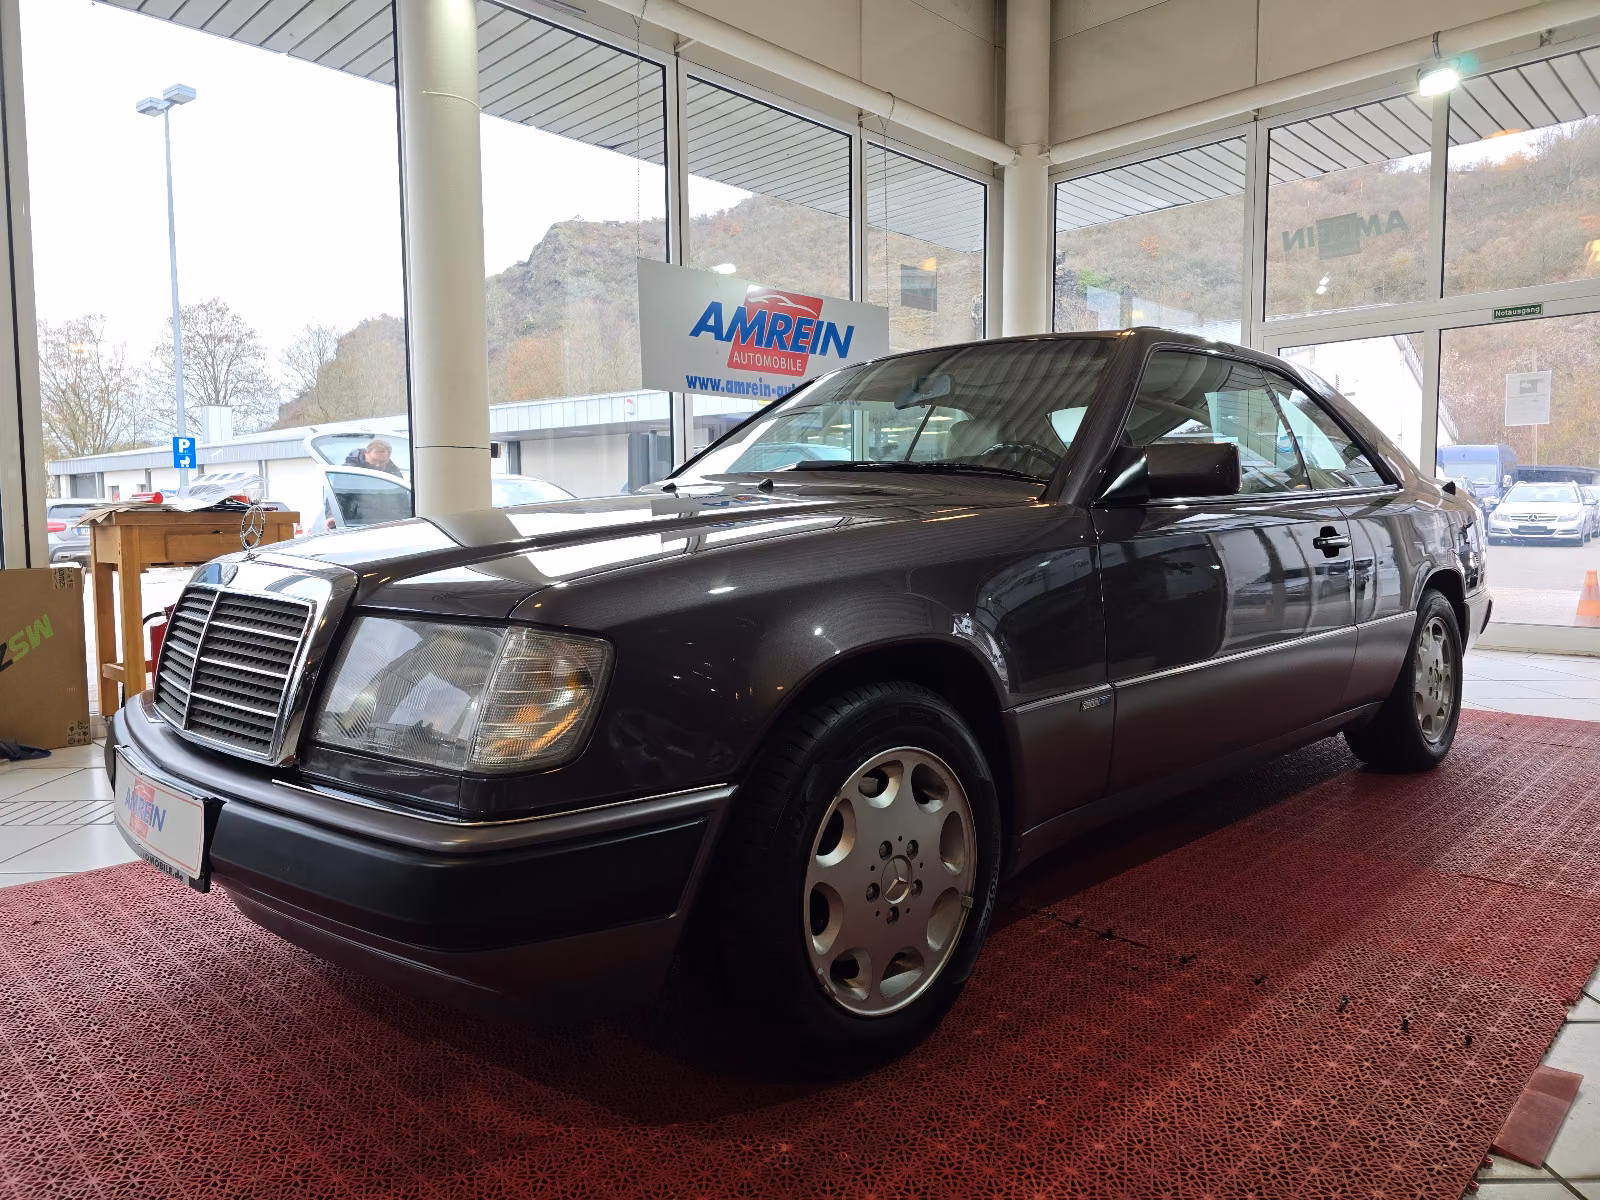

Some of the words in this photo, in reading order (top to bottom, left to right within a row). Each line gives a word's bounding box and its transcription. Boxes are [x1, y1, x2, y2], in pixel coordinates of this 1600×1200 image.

[1495, 306, 1540, 317] Notausgang
[689, 301, 854, 358] AMREIN
[733, 351, 802, 371] AUTOMOBILE
[178, 438, 190, 453] P
[124, 787, 167, 832] AMREIN
